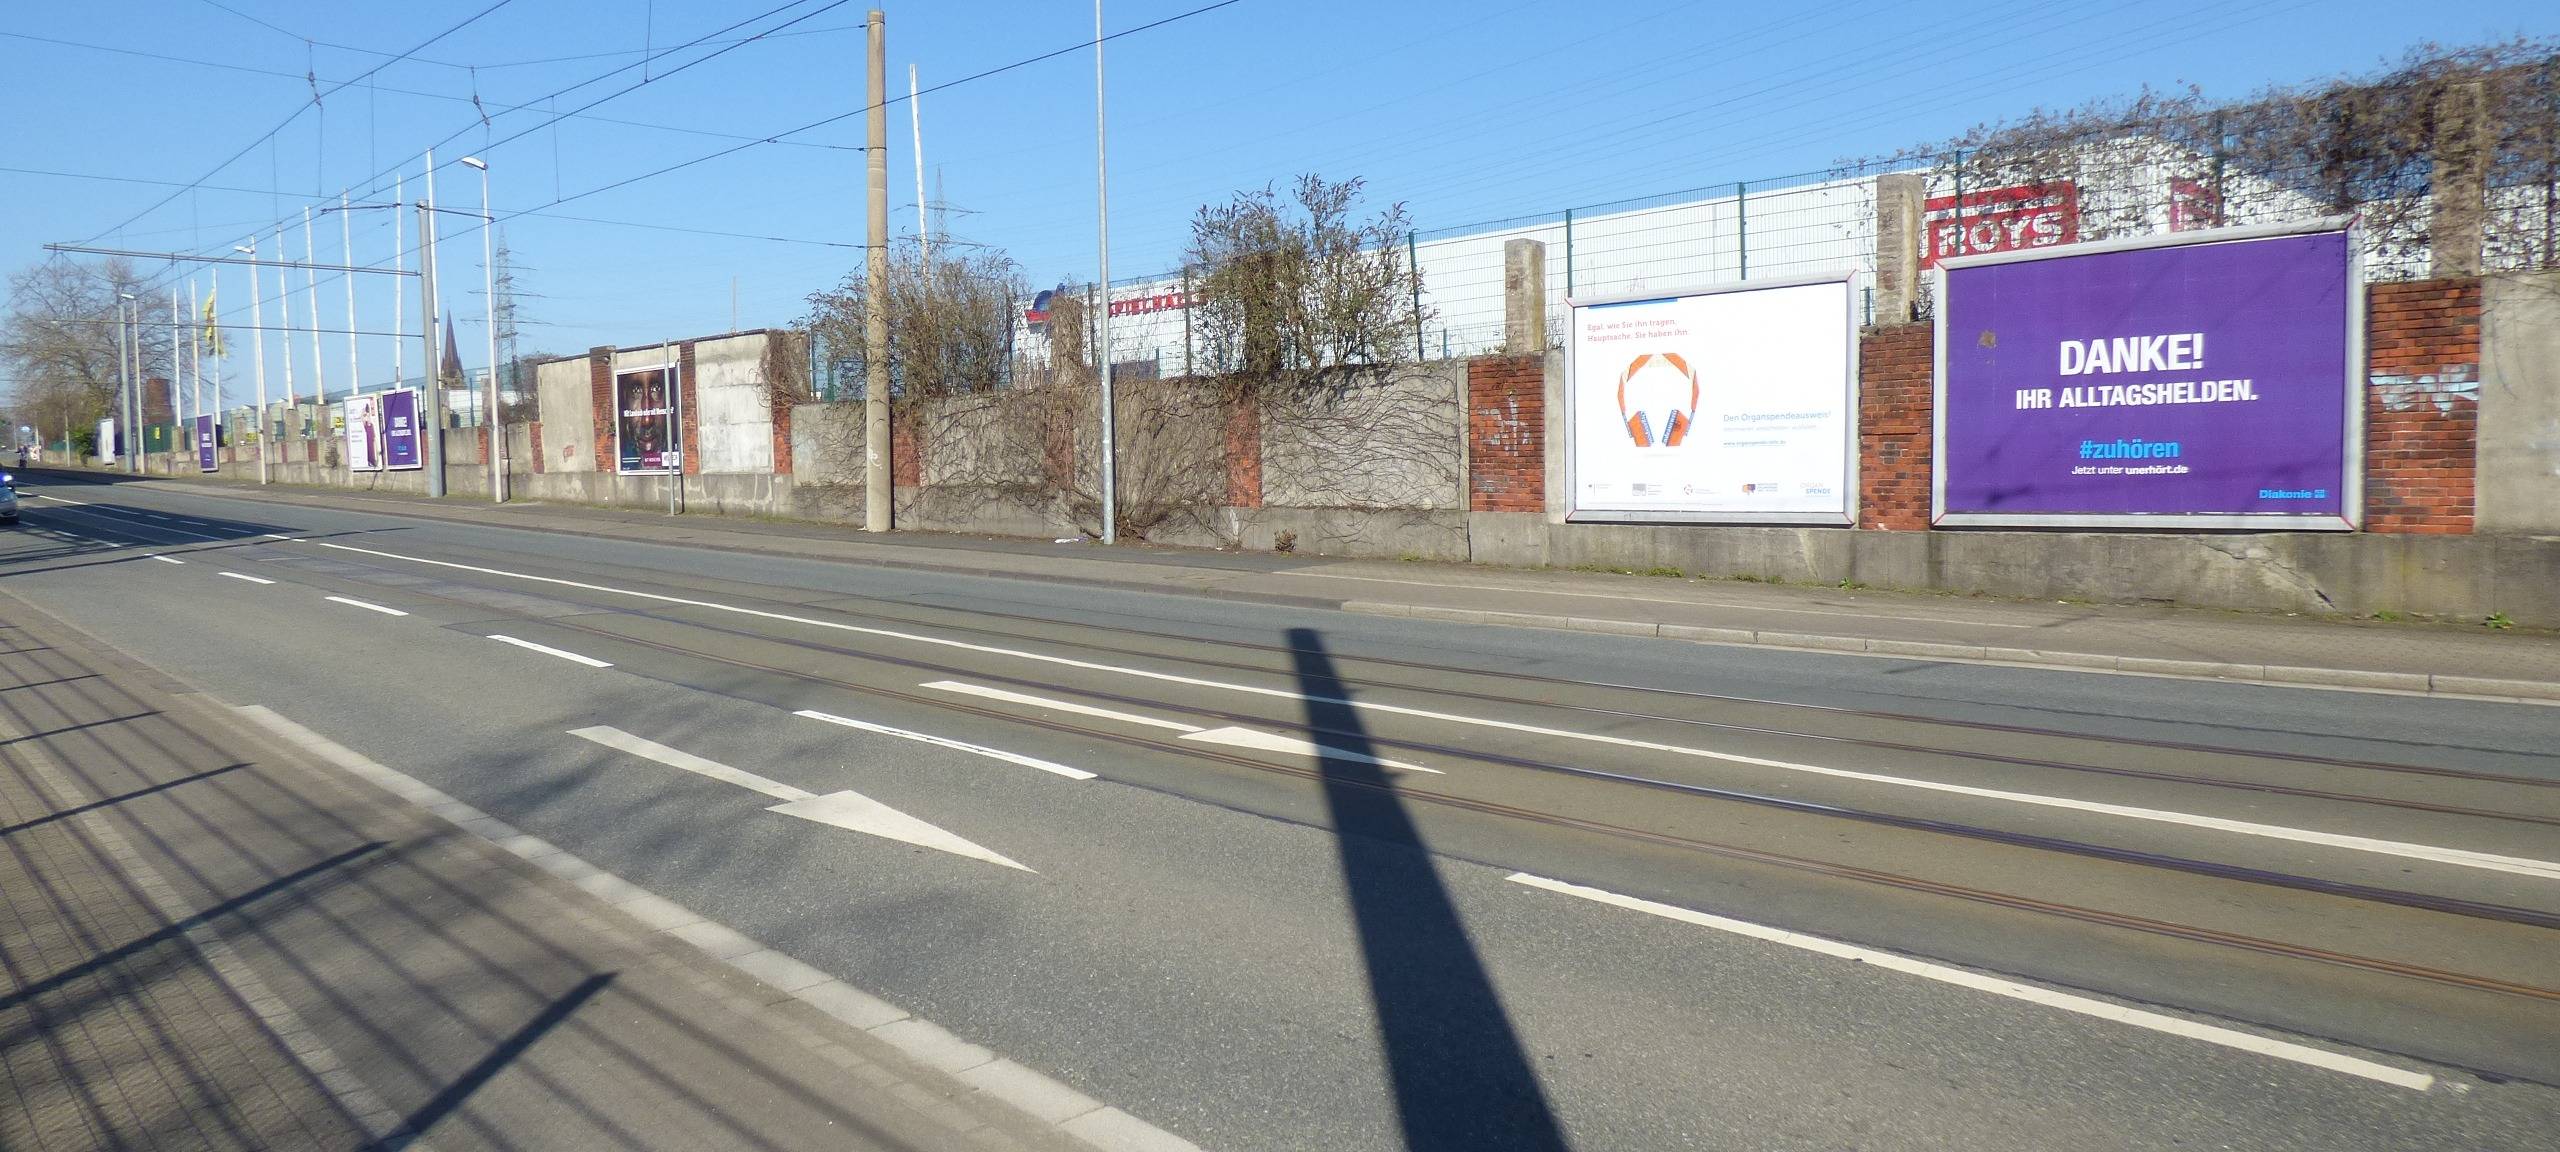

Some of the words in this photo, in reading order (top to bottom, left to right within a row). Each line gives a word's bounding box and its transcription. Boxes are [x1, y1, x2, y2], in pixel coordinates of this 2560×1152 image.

[1607, 322, 1620, 330] wie
[1622, 321, 1633, 329] Sie
[1634, 331, 1646, 339] Sie
[1648, 330, 1673, 338] haben
[2059, 333, 2204, 375] DANKE!
[2016, 388, 2052, 410] IHR
[2059, 379, 2260, 408] ALLTAGSHELDEN.
[1723, 414, 1740, 422] Den
[2080, 438, 2180, 459] #zuhören
[2071, 466, 2096, 475] Jetzt
[2098, 466, 2123, 475] unter
[2125, 464, 2190, 475] unerhört.de
[2259, 489, 2312, 499] Diakonie
